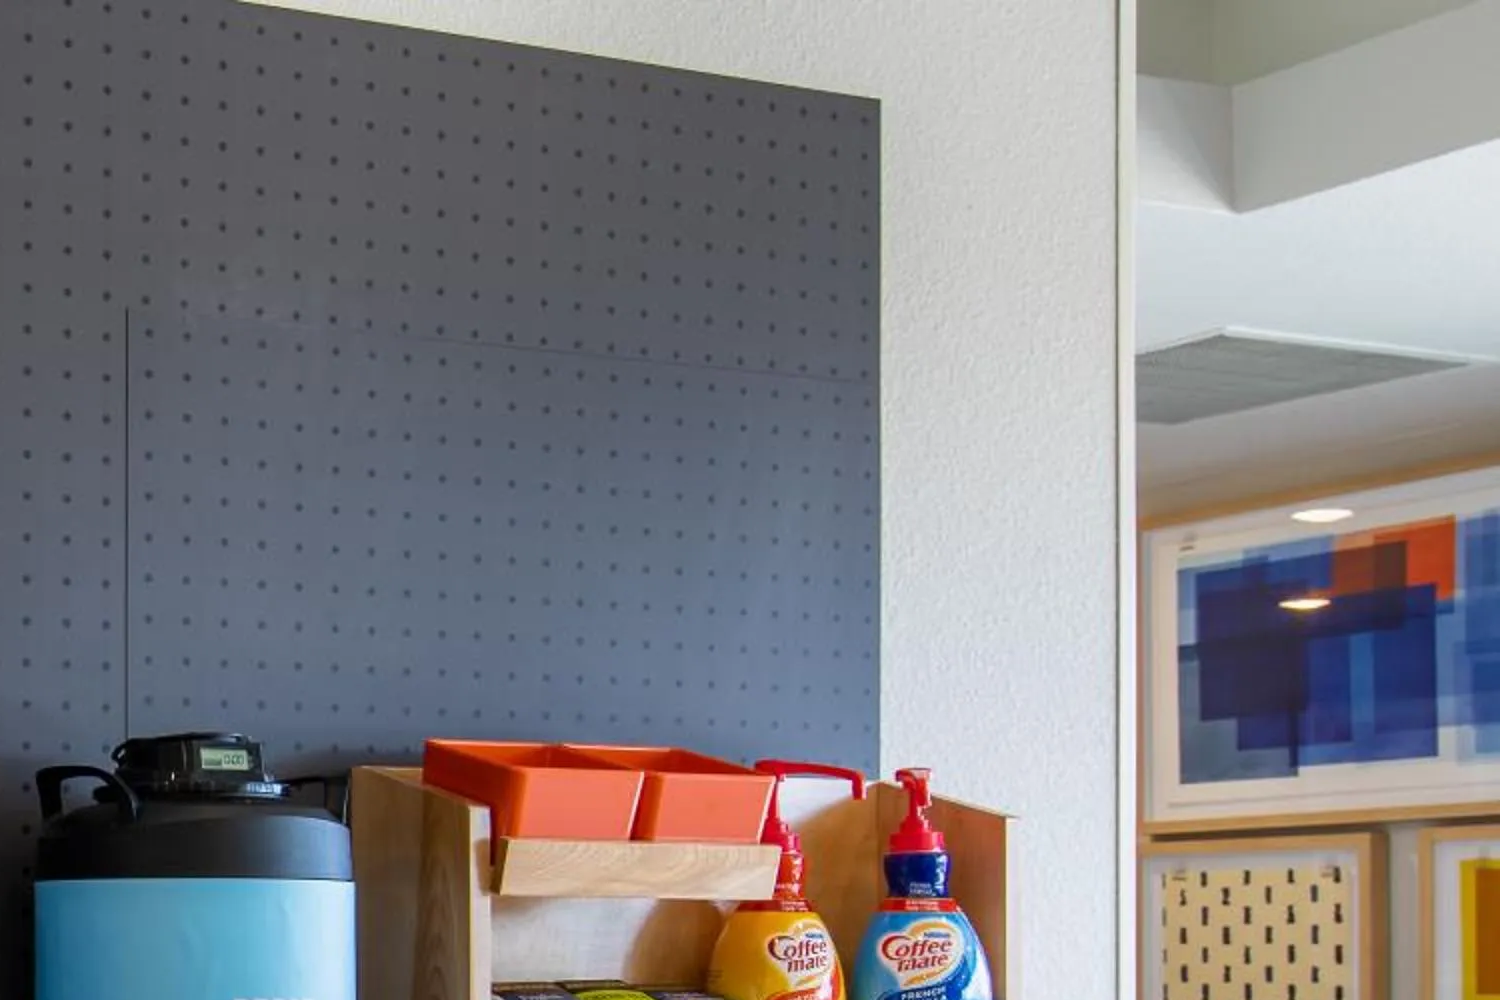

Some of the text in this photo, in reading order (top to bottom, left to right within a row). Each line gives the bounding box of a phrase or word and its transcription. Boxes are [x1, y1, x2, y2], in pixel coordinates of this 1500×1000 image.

[767, 935, 828, 961] Coffee
[881, 935, 954, 961] Coffee
[787, 955, 828, 973] mate
[896, 954, 949, 973] mate
